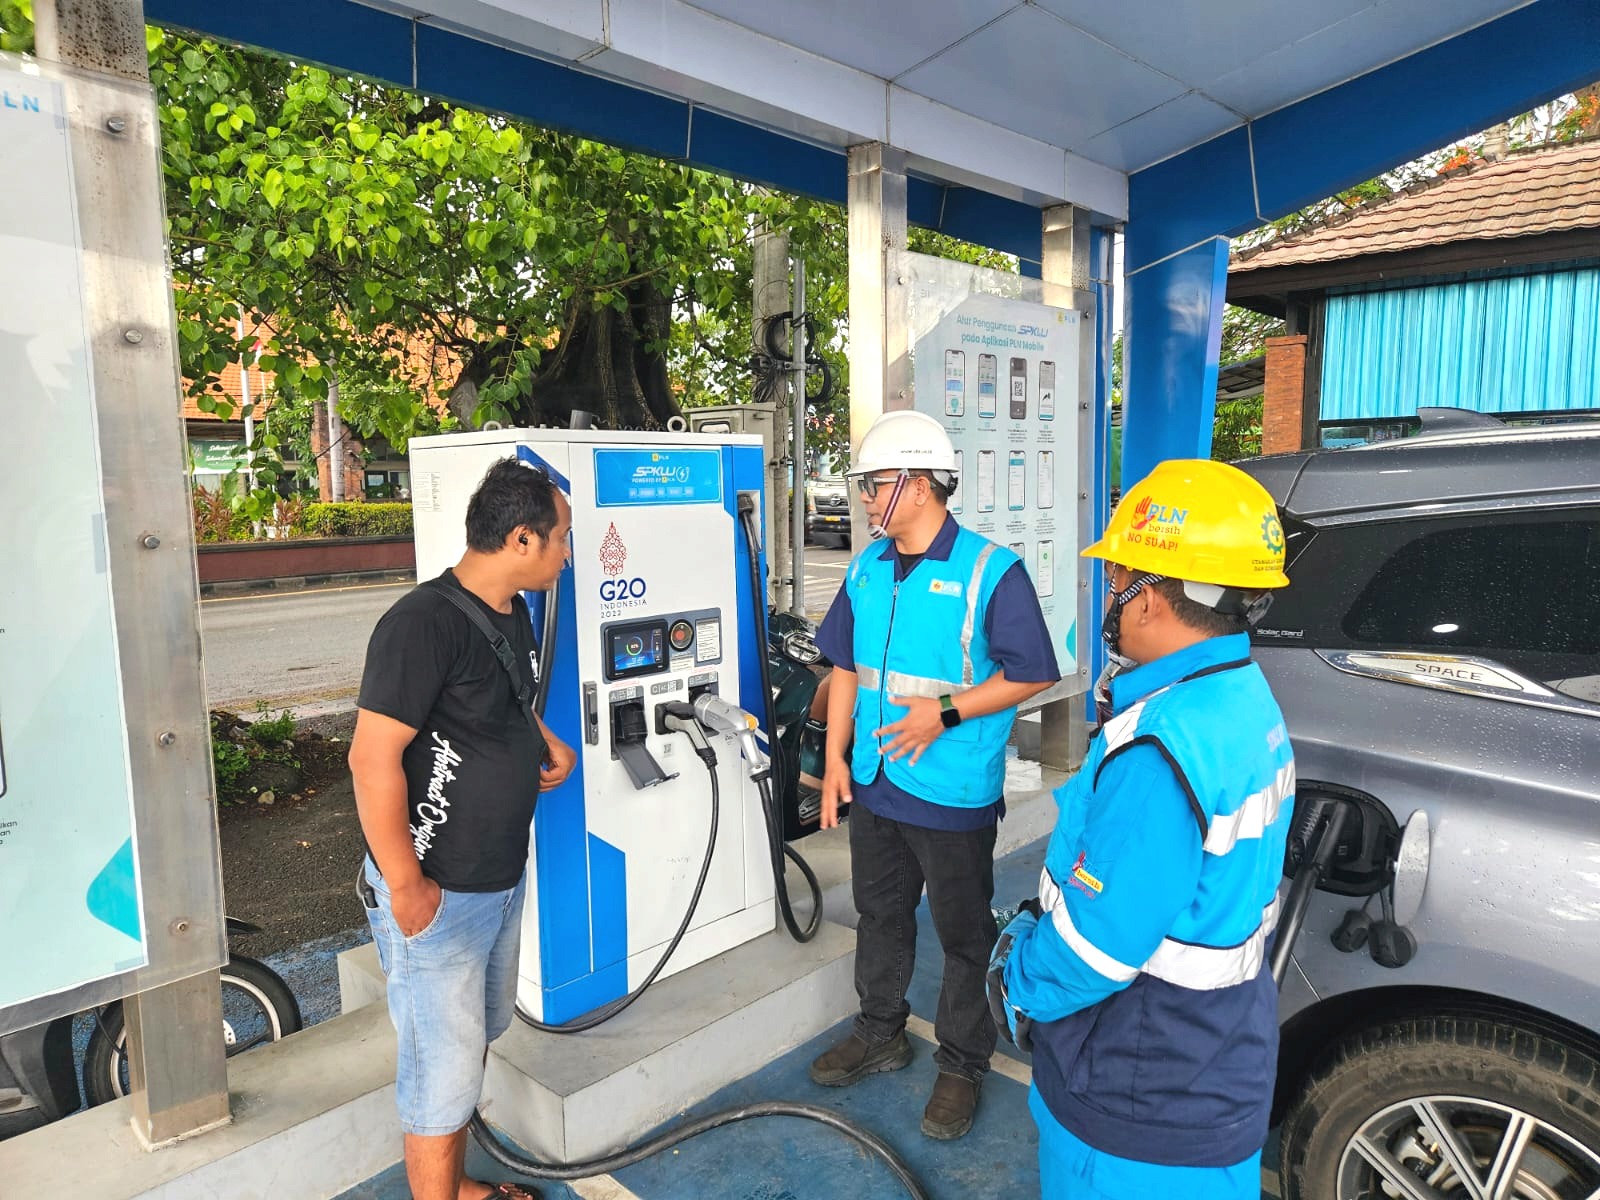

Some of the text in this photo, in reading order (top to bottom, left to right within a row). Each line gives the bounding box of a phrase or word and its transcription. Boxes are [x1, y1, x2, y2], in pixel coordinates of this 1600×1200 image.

[0, 90, 40, 113] LN
[956, 313, 971, 325] Alur
[961, 333, 1045, 351] pada Aplikasi PLN Mobile
[632, 466, 677, 477] SPKLU
[1147, 503, 1188, 525] PLN
[1148, 523, 1181, 535] bersih
[1127, 531, 1179, 552] NO SUAP!
[600, 577, 646, 601] G20
[600, 599, 648, 610] INDONESIA
[600, 609, 622, 619] 2022
[1256, 629, 1280, 637] Solar
[1415, 663, 1483, 680] SPACE
[427, 731, 463, 807] Abstract
